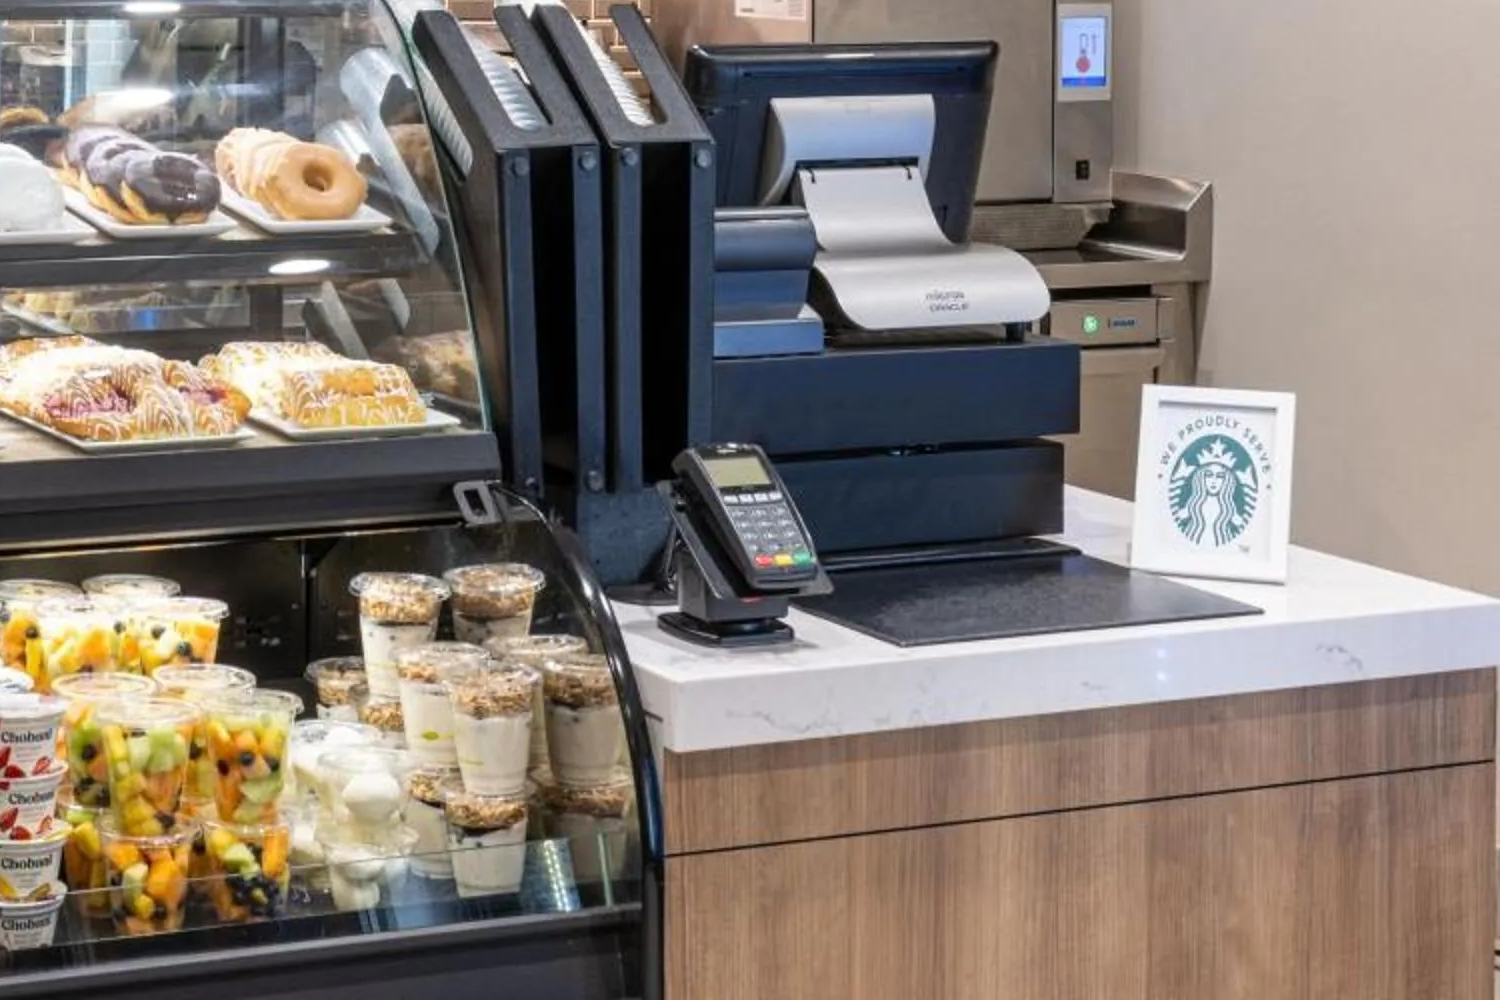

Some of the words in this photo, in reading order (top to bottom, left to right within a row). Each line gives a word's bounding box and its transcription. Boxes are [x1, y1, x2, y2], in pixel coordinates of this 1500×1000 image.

[1178, 415, 1240, 440] PROUDLY
[1243, 427, 1271, 474] SERVE
[1, 726, 52, 744] Chobani
[1, 853, 52, 871] Chobani
[1, 914, 51, 932] Chobani
